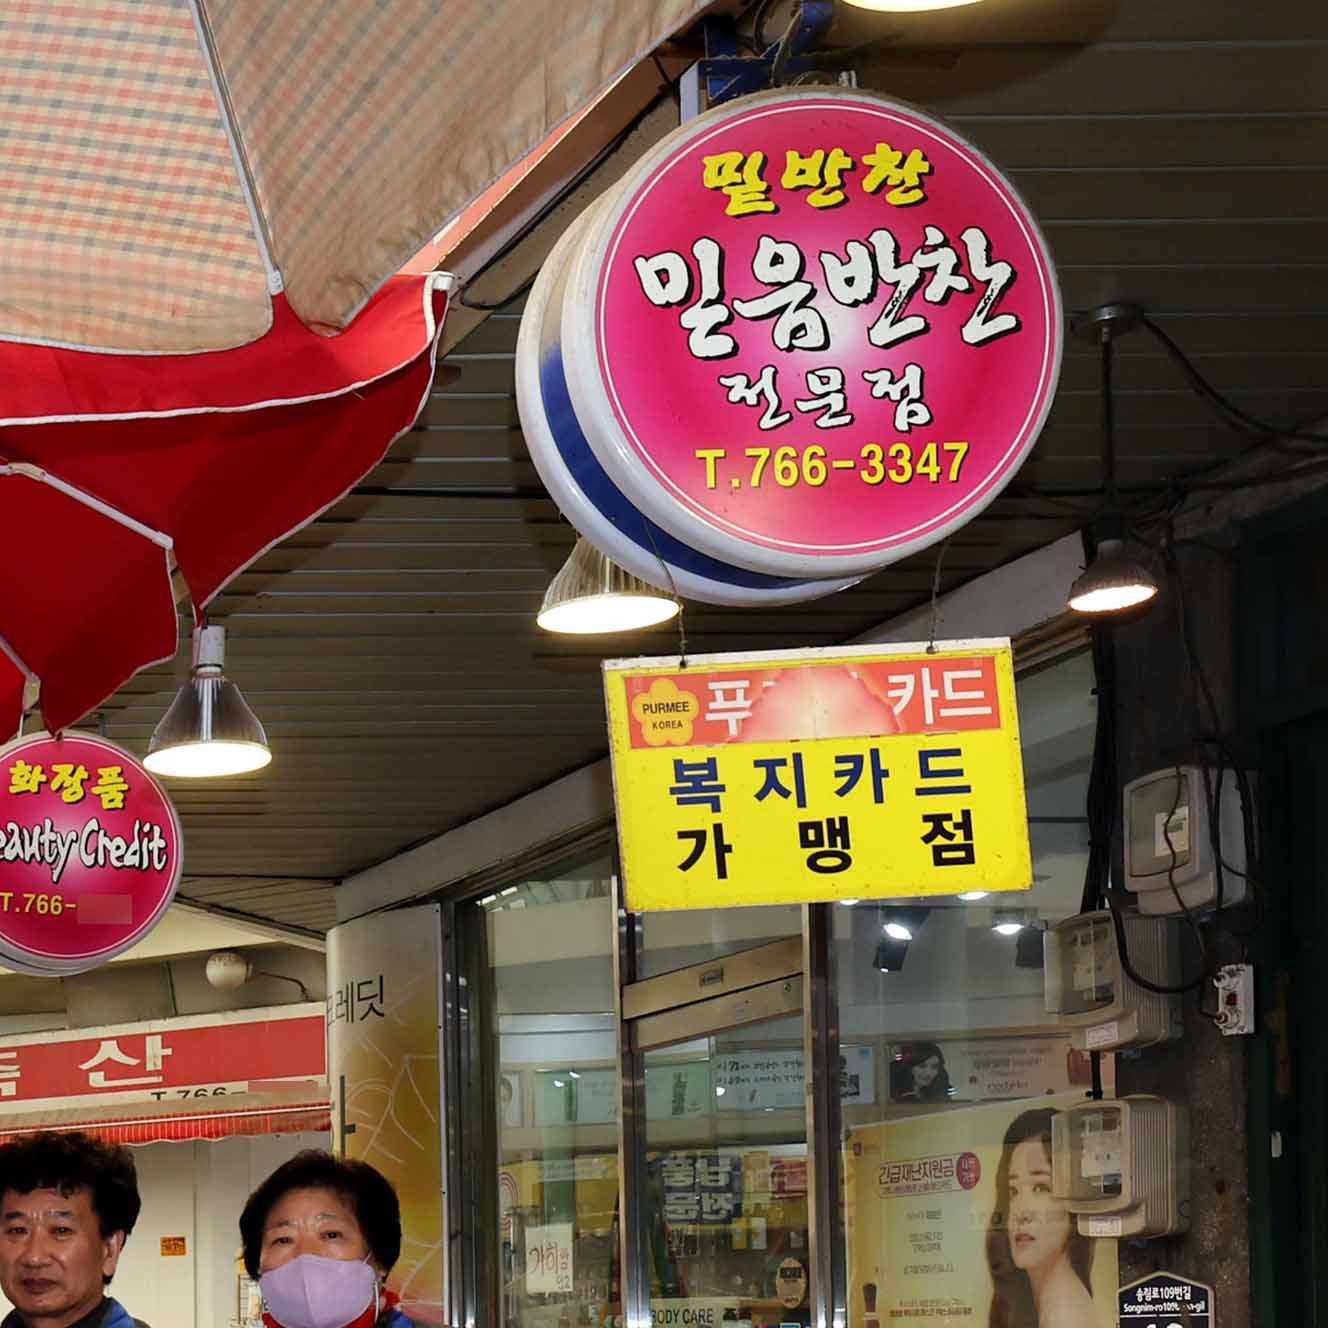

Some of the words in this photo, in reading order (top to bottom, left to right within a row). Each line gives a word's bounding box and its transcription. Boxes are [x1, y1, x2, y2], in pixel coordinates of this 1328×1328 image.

[720, 364, 933, 431] 전문점
[695, 442, 970, 489] T.766-3347
[643, 701, 690, 714] PURMEE
[652, 720, 683, 730] KOREA
[9, 760, 129, 809] 화장품
[669, 747, 972, 813] 복지카드
[80, 818, 168, 871] Credit
[677, 808, 977, 879] 가맹점
[879, 1159, 954, 1185] 긴급재난지원금
[682, 1308, 713, 1324] CARE
